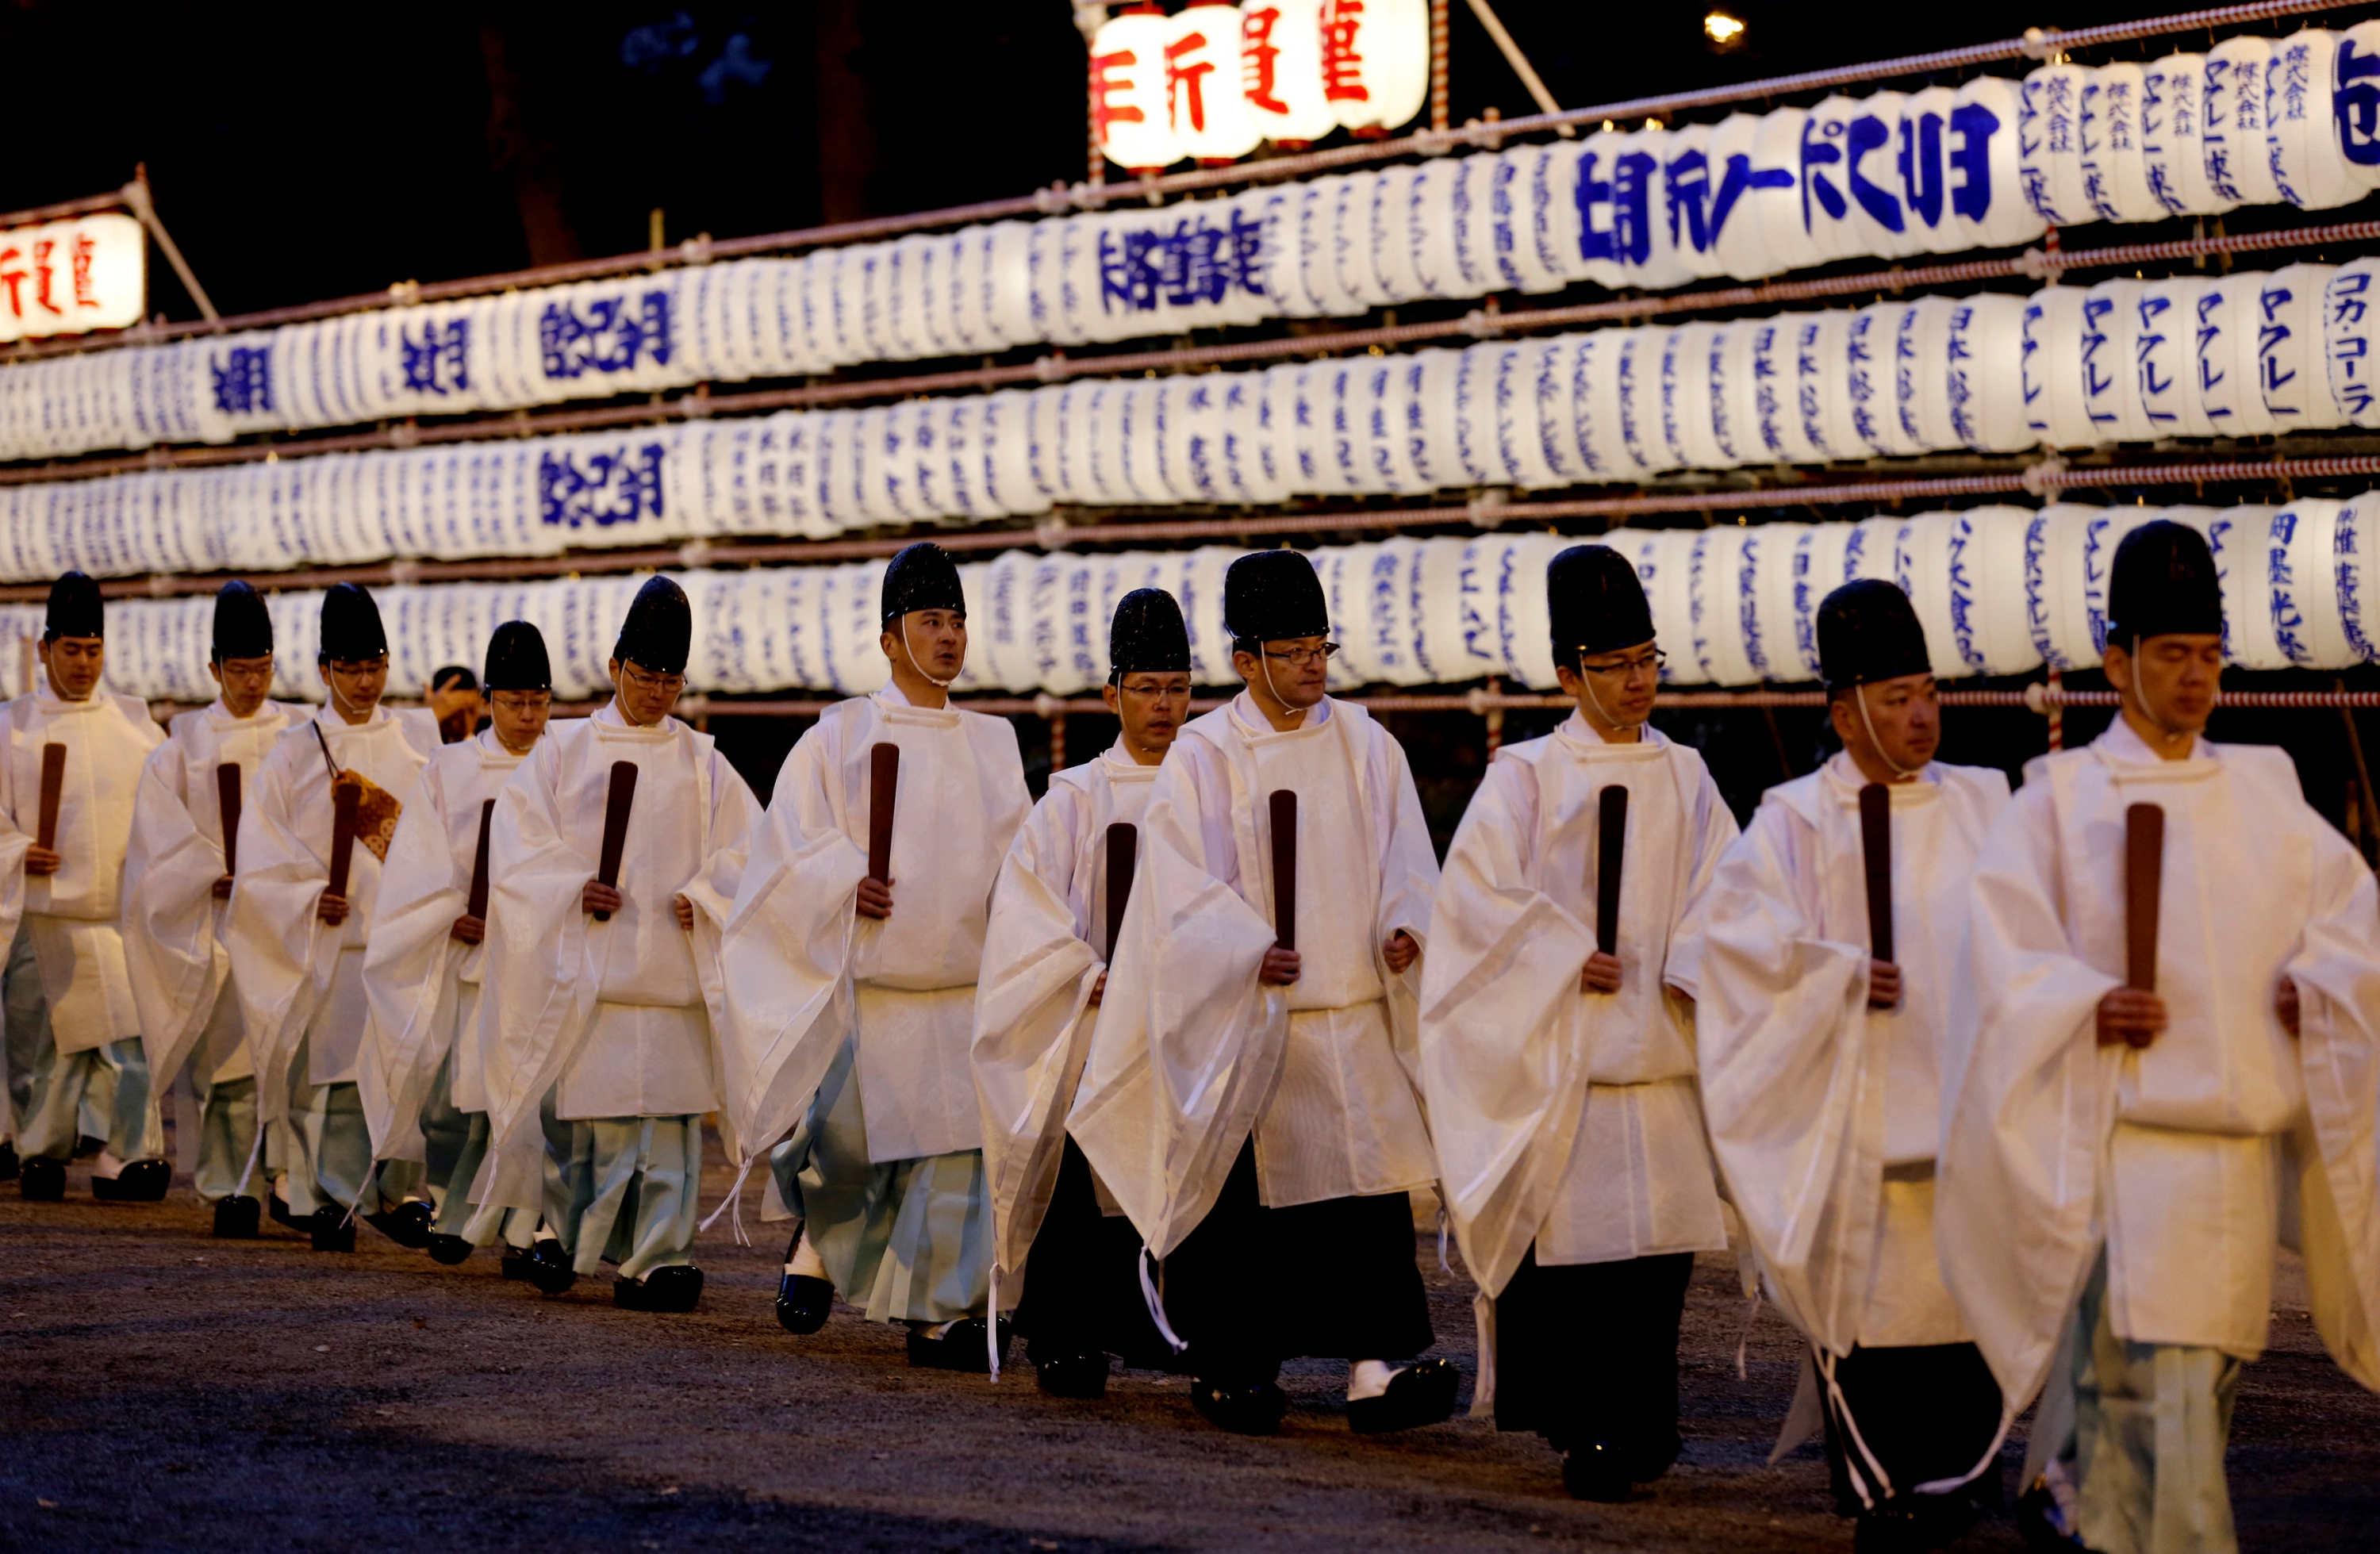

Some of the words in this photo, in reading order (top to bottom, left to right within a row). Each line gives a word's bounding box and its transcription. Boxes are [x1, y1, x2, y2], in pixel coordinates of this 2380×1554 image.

[2047, 75, 2073, 153] 株式会社
[2107, 82, 2133, 150] 株式会社
[2172, 75, 2195, 135] 株式会社
[2233, 62, 2261, 130] 株式会社
[2285, 44, 2310, 121] 株式会社
[2334, 274, 2374, 415] コカ・コーラ
